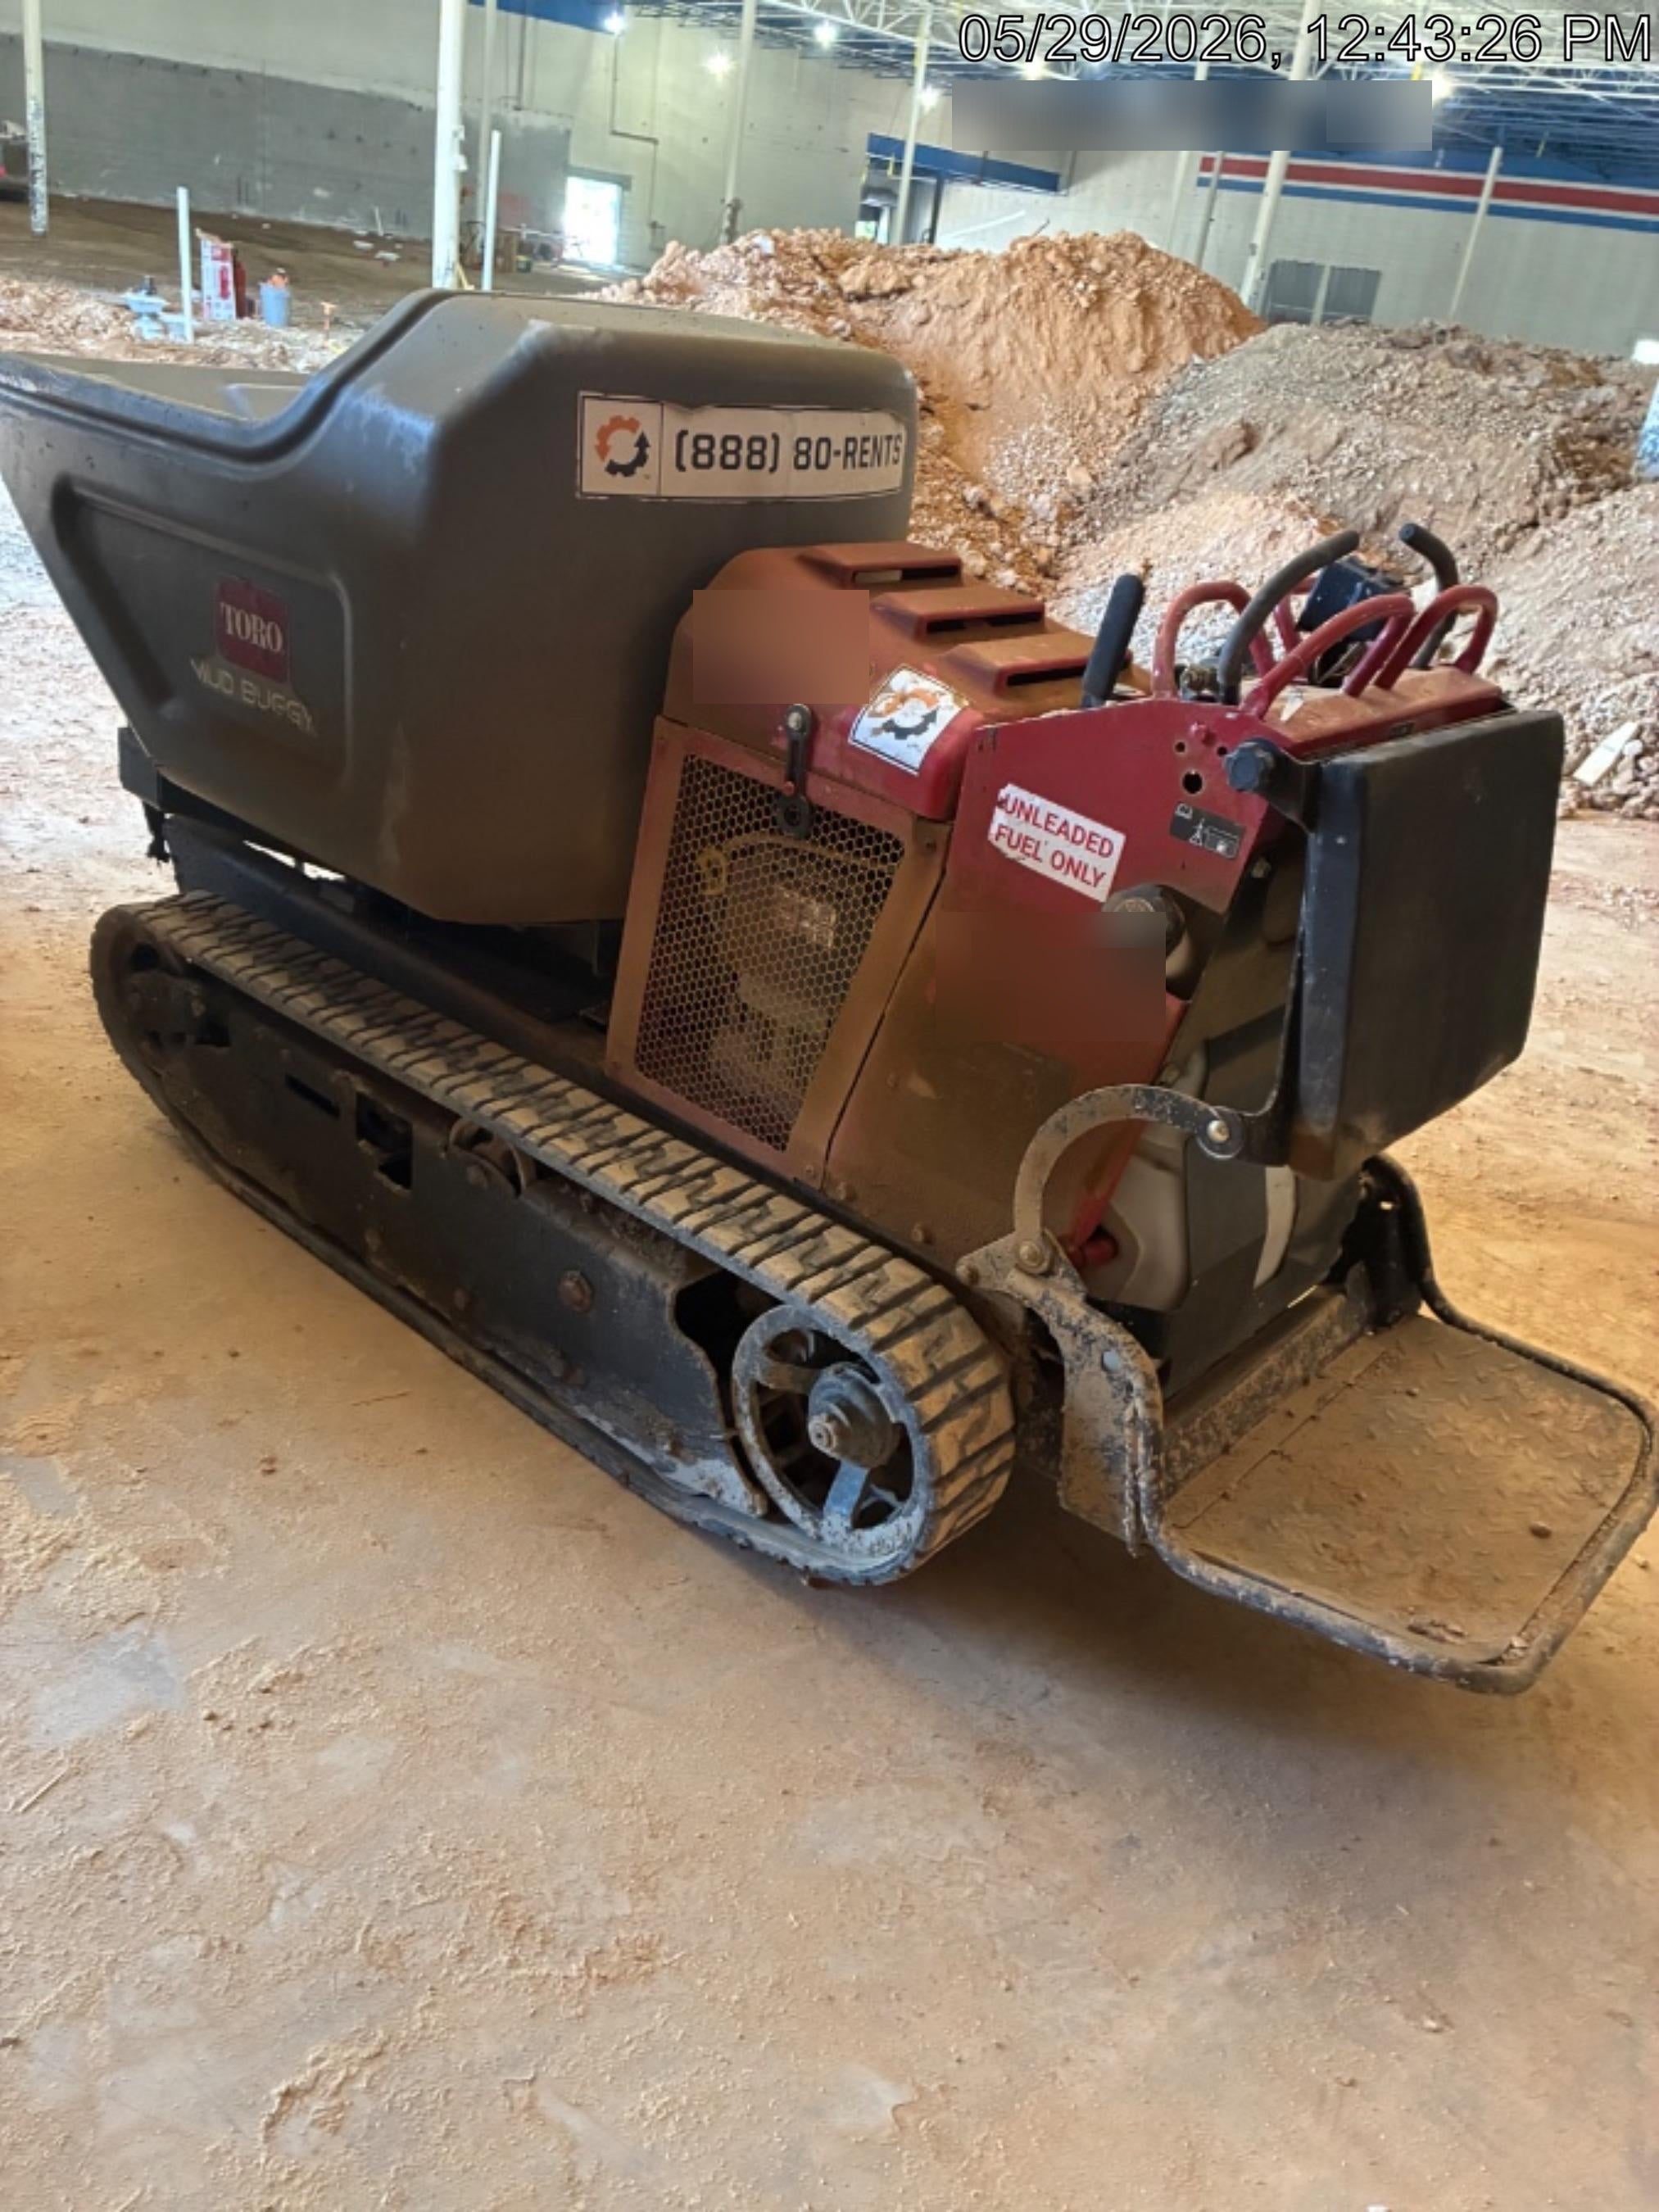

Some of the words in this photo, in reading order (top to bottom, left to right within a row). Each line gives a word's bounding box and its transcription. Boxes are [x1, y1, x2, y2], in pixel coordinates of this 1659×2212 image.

[675, 430, 780, 473] (888)
[793, 434, 903, 471] 80-RENTS
[220, 602, 283, 652] TORO
[1003, 794, 1114, 859] UNLEADED
[995, 823, 1044, 862] FUEL
[1049, 850, 1107, 888] ONLY
